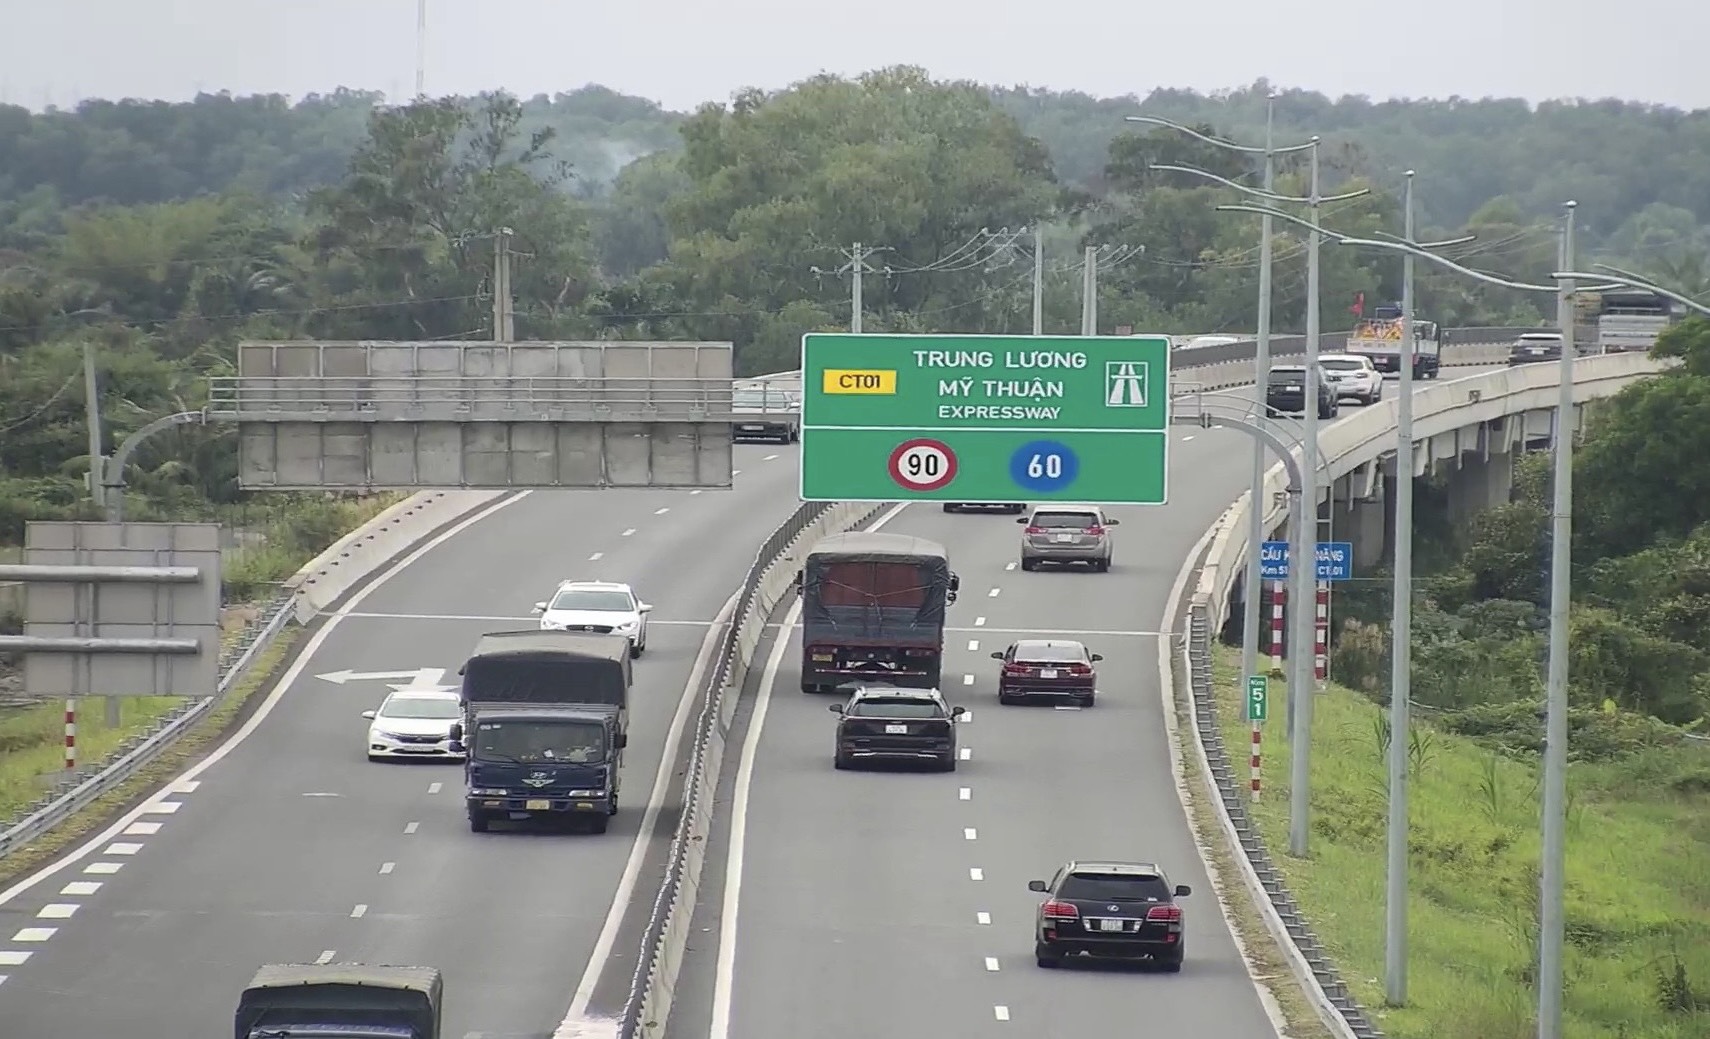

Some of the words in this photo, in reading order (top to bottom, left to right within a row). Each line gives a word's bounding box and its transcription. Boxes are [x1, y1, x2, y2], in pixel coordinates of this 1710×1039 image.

[913, 350, 993, 368] TRUNG
[1005, 350, 1087, 368] LƯƠNG
[839, 374, 881, 389] CT01
[939, 376, 973, 398] MỸ
[983, 376, 1063, 402] THUẬN
[938, 405, 1061, 419] EXPRESSWAY
[908, 454, 939, 476] 90
[1028, 454, 1062, 478] 60
[1261, 565, 1278, 575] Km
